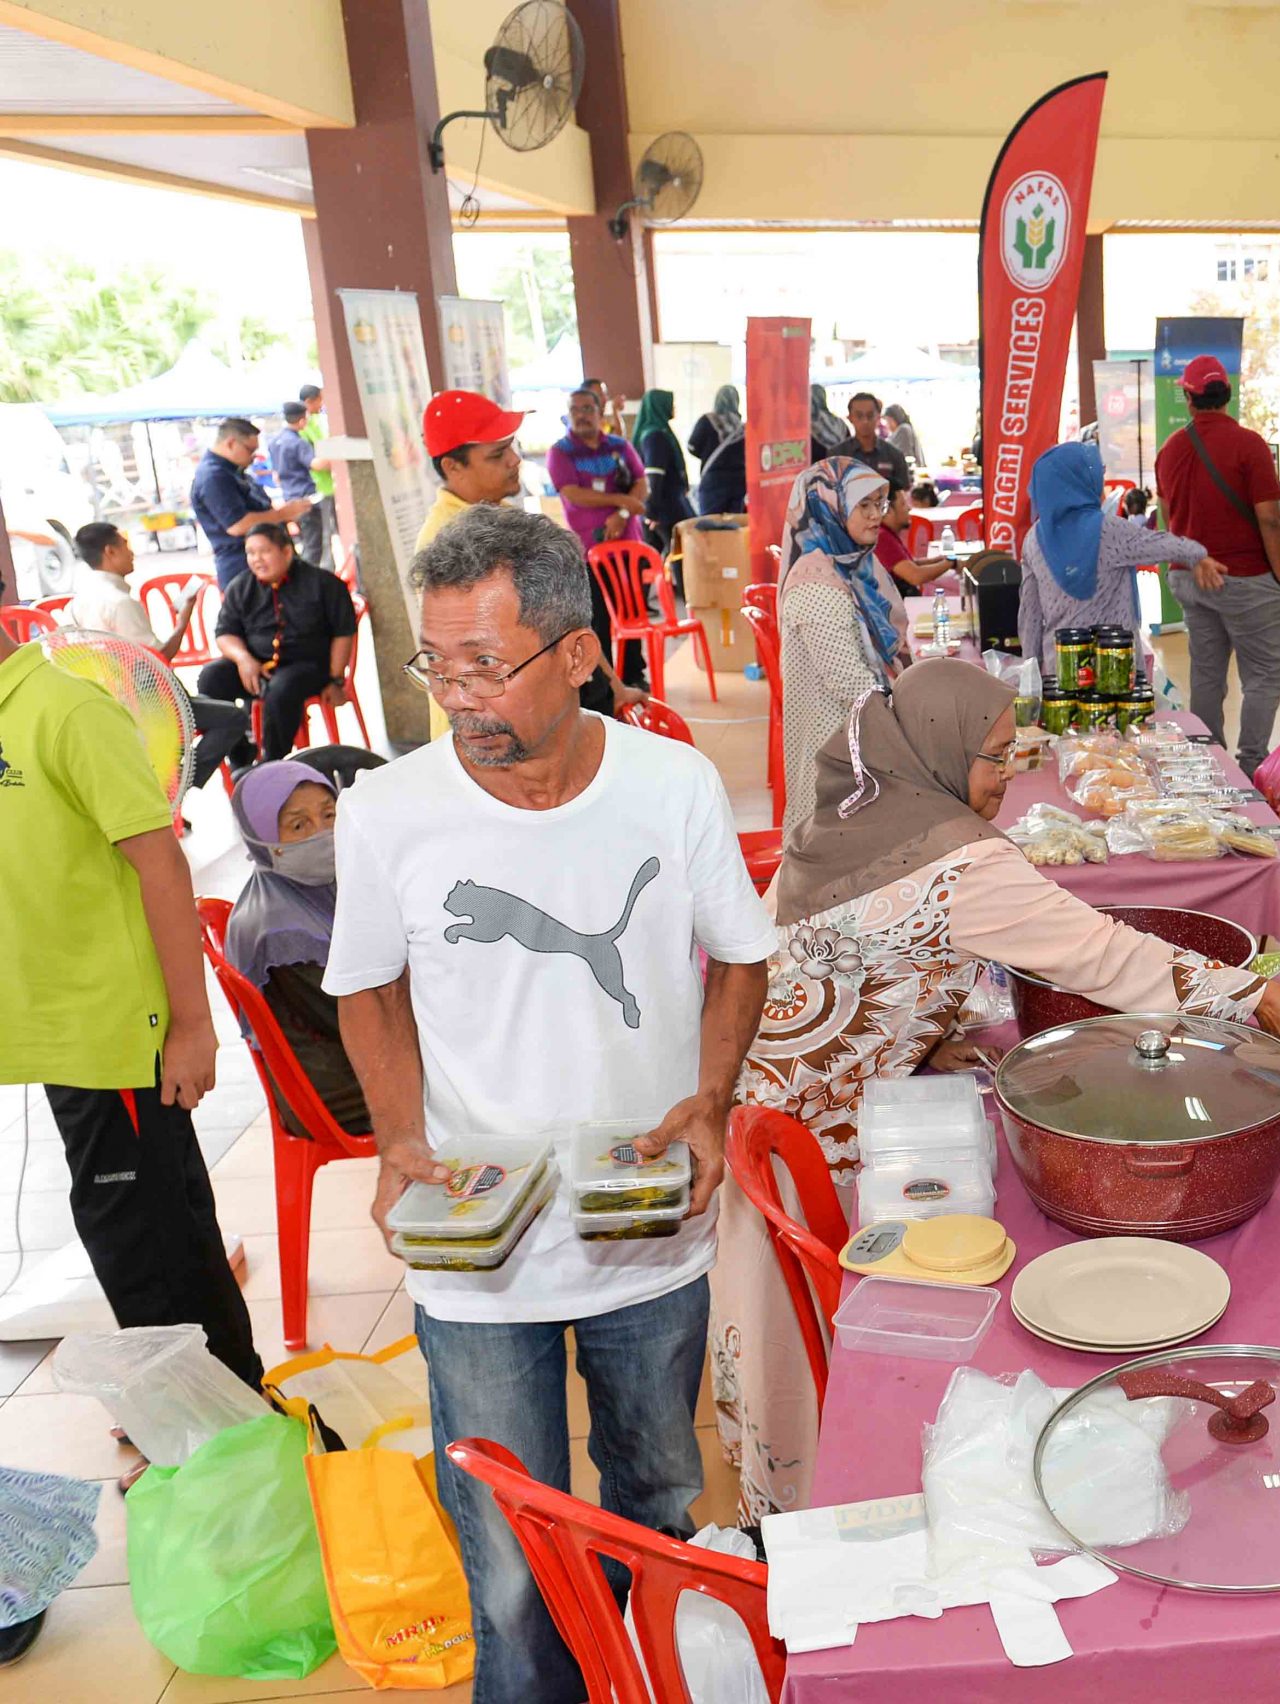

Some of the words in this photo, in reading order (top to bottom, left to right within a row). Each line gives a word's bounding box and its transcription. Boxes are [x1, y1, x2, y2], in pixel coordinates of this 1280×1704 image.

[1014, 181, 1060, 206] NAFAS
[1000, 297, 1046, 437] SERVICES
[992, 443, 1024, 516] AGRI
